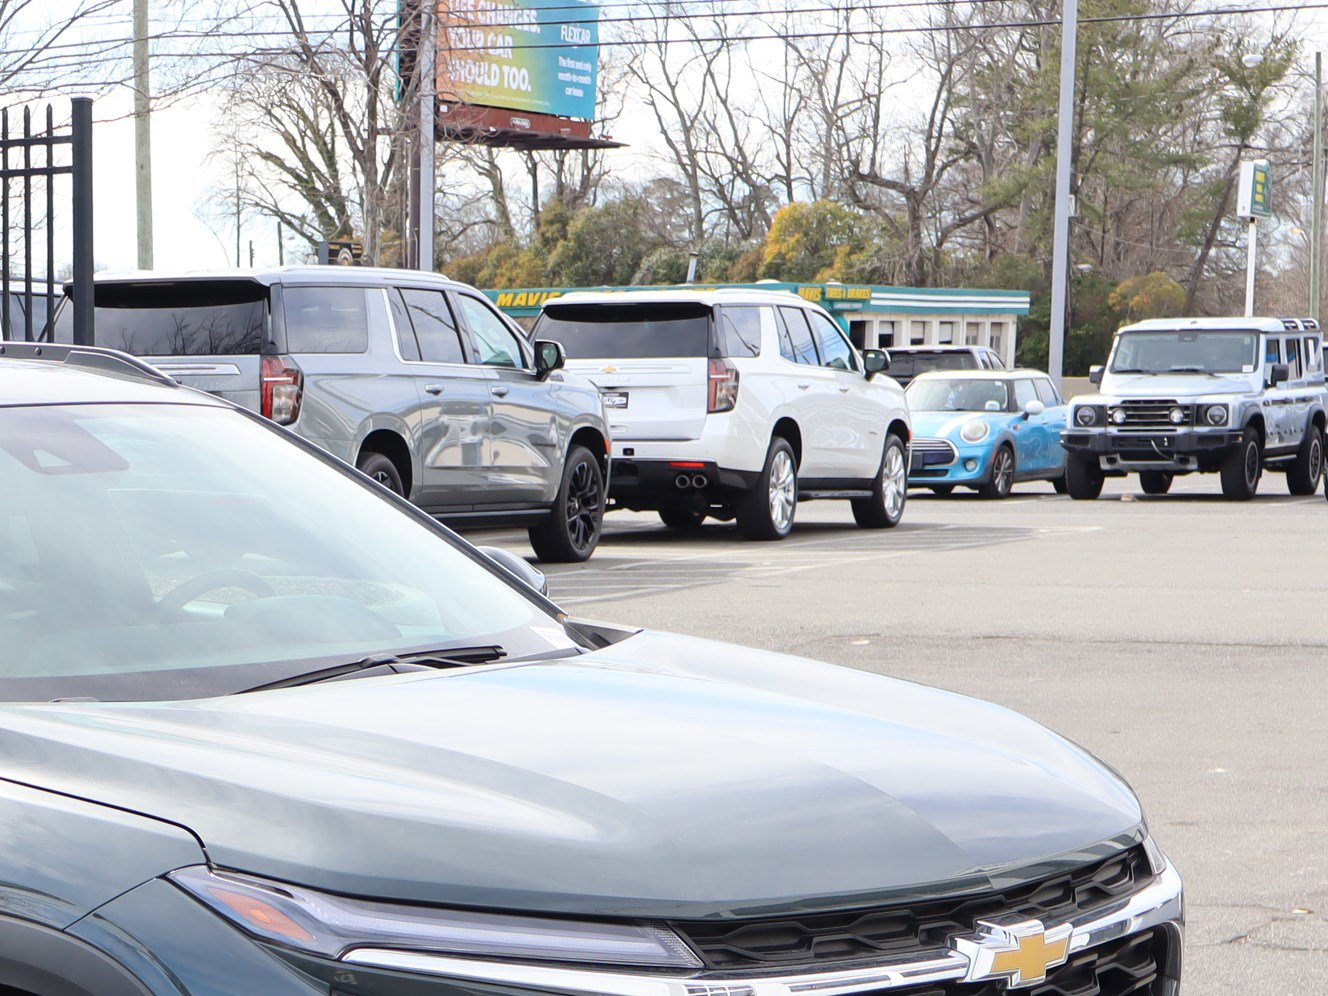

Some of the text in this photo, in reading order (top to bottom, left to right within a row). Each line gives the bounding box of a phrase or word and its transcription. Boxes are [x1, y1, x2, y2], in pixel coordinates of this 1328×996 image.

[487, 32, 513, 59] CAR
[560, 24, 591, 44] FLEXCAR
[501, 65, 532, 92] TOO.
